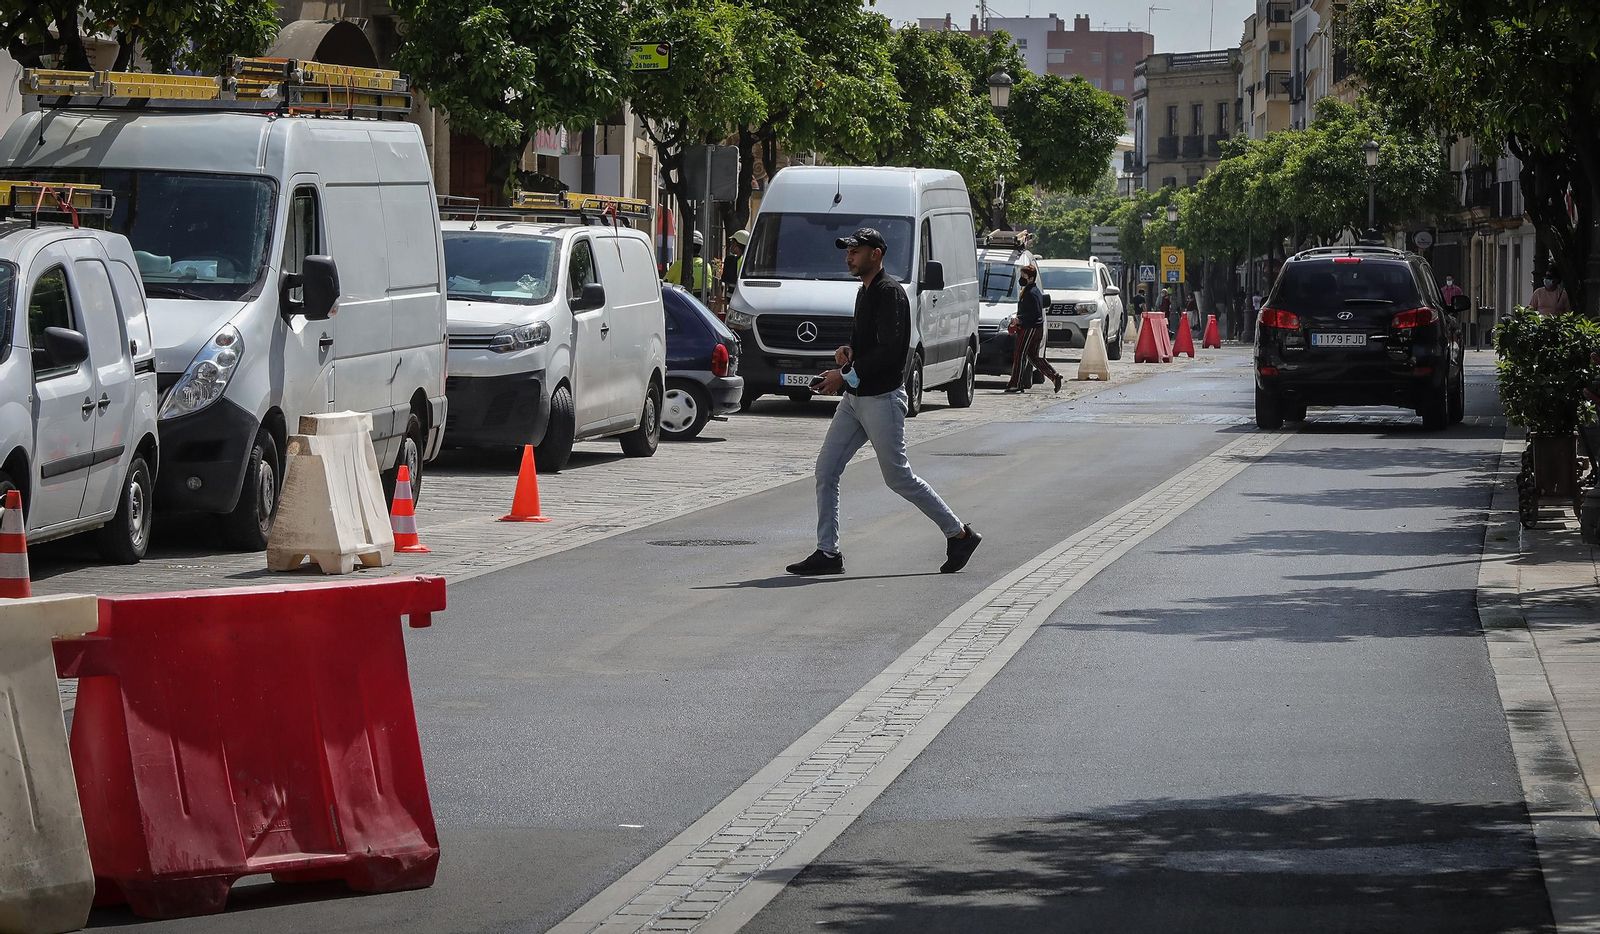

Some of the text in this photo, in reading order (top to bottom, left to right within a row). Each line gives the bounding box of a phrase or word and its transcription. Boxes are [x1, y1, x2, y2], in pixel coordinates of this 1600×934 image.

[1320, 335, 1364, 344] 1179 FJD
[787, 375, 809, 385] 5582
